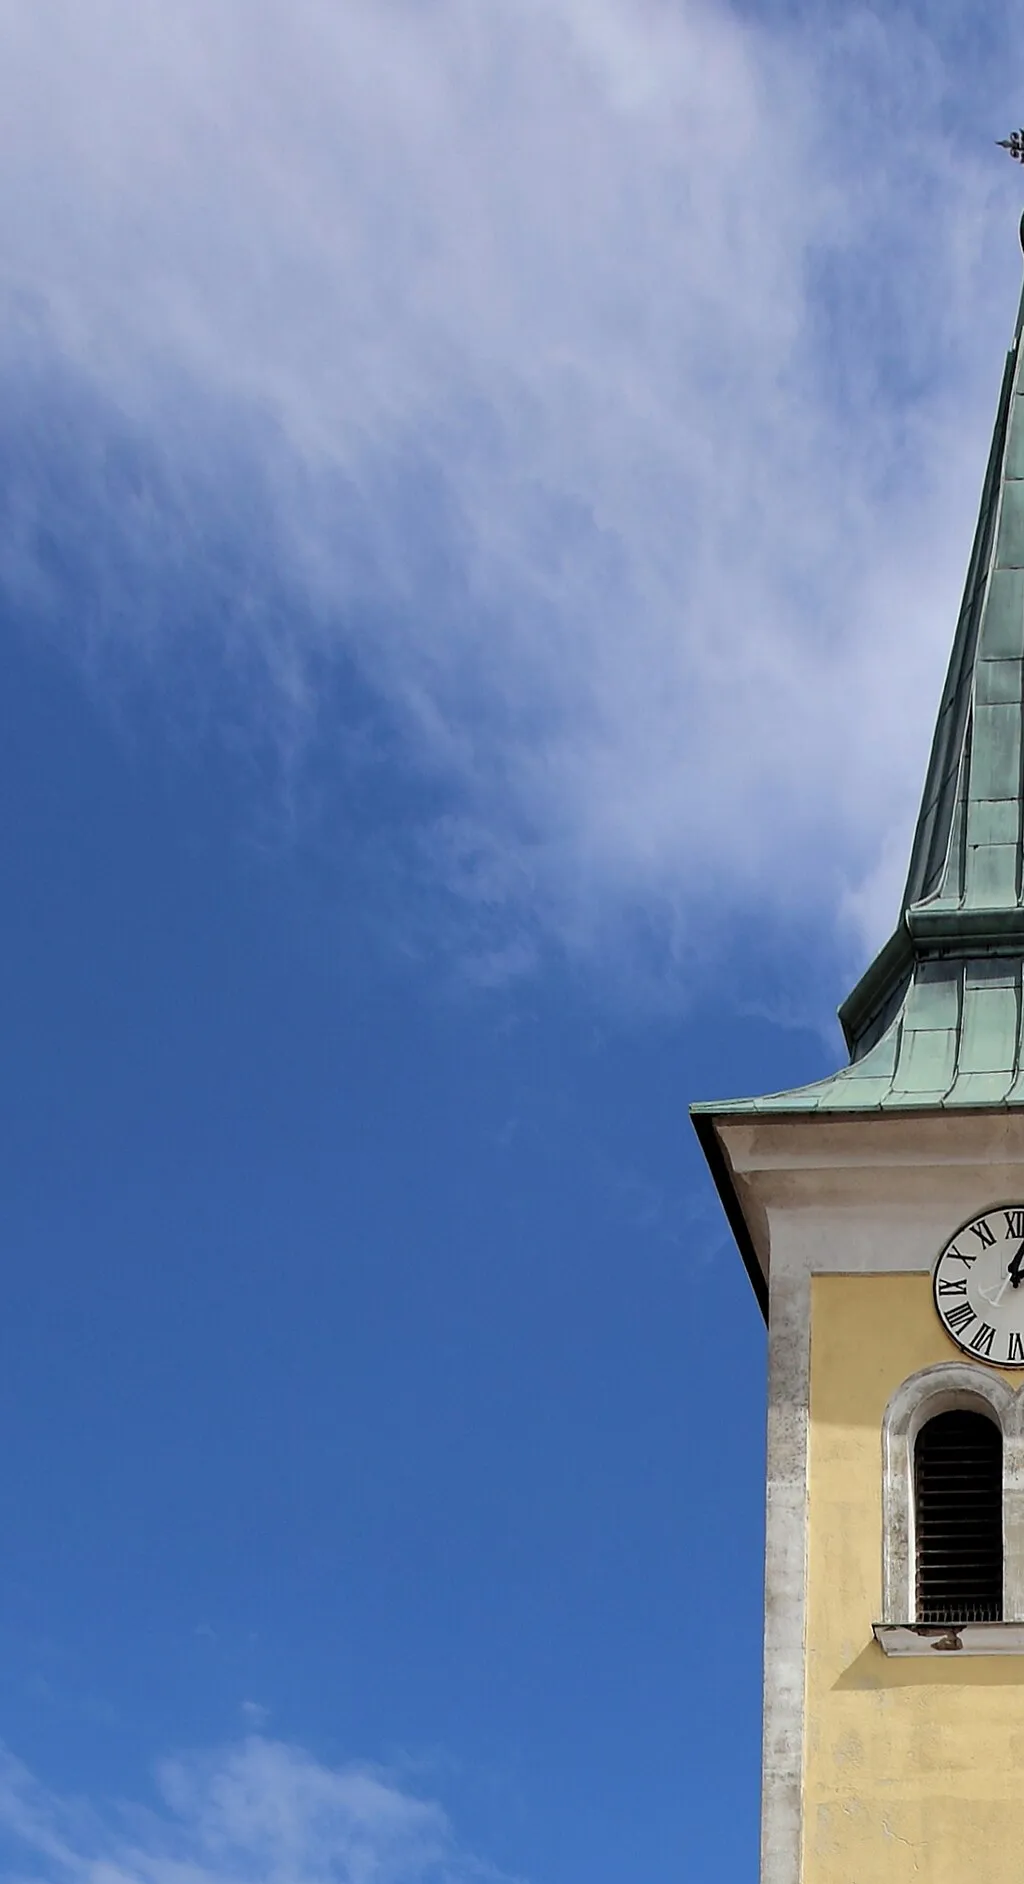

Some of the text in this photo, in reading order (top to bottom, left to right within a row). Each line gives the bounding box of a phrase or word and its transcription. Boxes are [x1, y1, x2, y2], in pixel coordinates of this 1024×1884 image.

[970, 1220, 997, 1249] XI
[947, 1246, 977, 1269] X
[939, 1279, 967, 1296] IX
[944, 1301, 977, 1335] VIII
[969, 1323, 996, 1355] VII
[1008, 1333, 1024, 1360] VI
